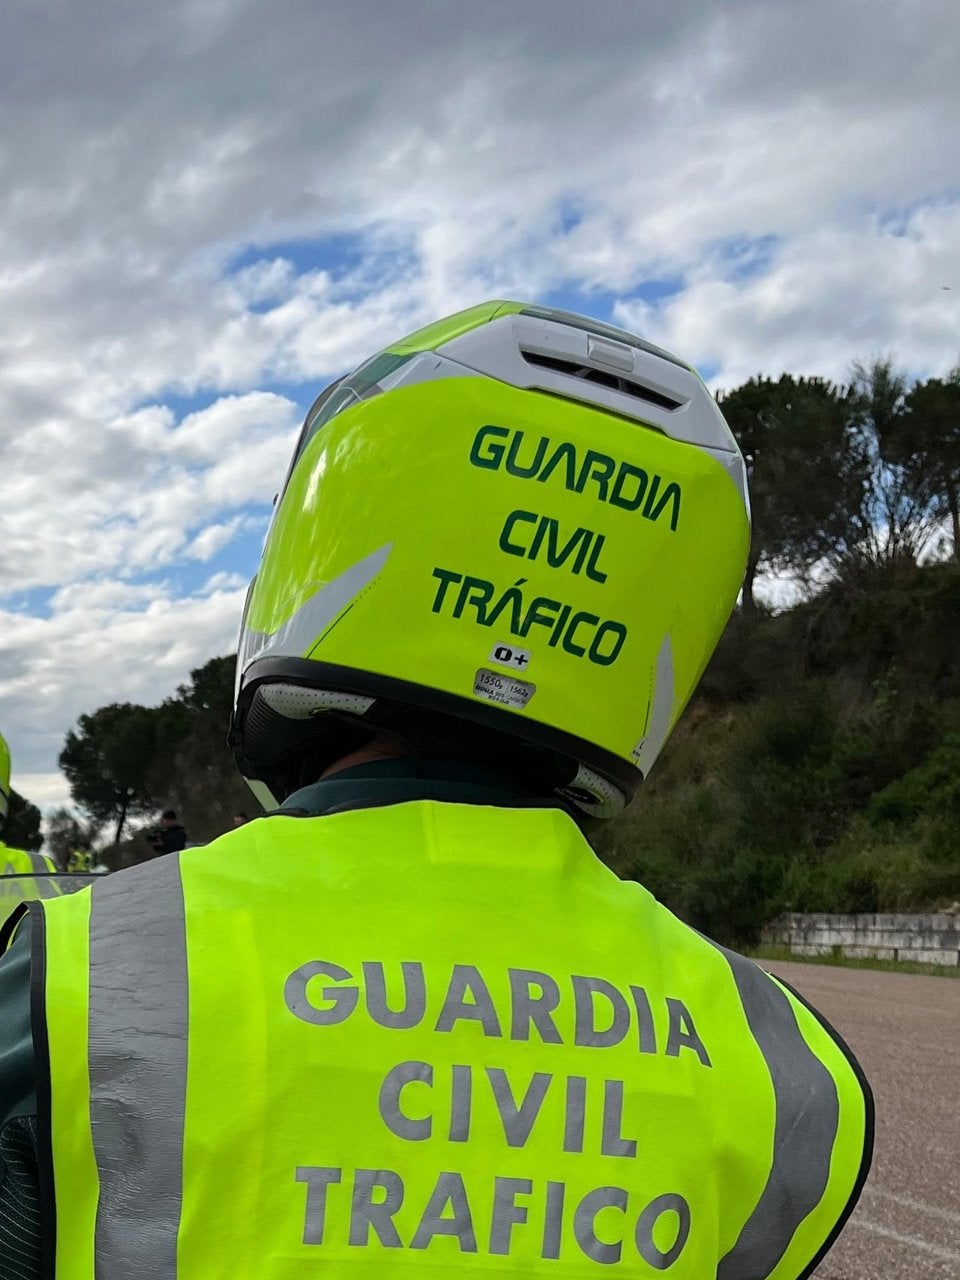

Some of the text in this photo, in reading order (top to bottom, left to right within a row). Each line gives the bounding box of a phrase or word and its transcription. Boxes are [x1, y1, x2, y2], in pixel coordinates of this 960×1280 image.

[469, 424, 681, 532] GUARDIA
[499, 510, 607, 584] CIVIL
[432, 567, 627, 666] TRÁFICO
[284, 960, 712, 1068] GUARDIA
[378, 1060, 638, 1158] CIVIL
[295, 1166, 691, 1271] TRAFICO
